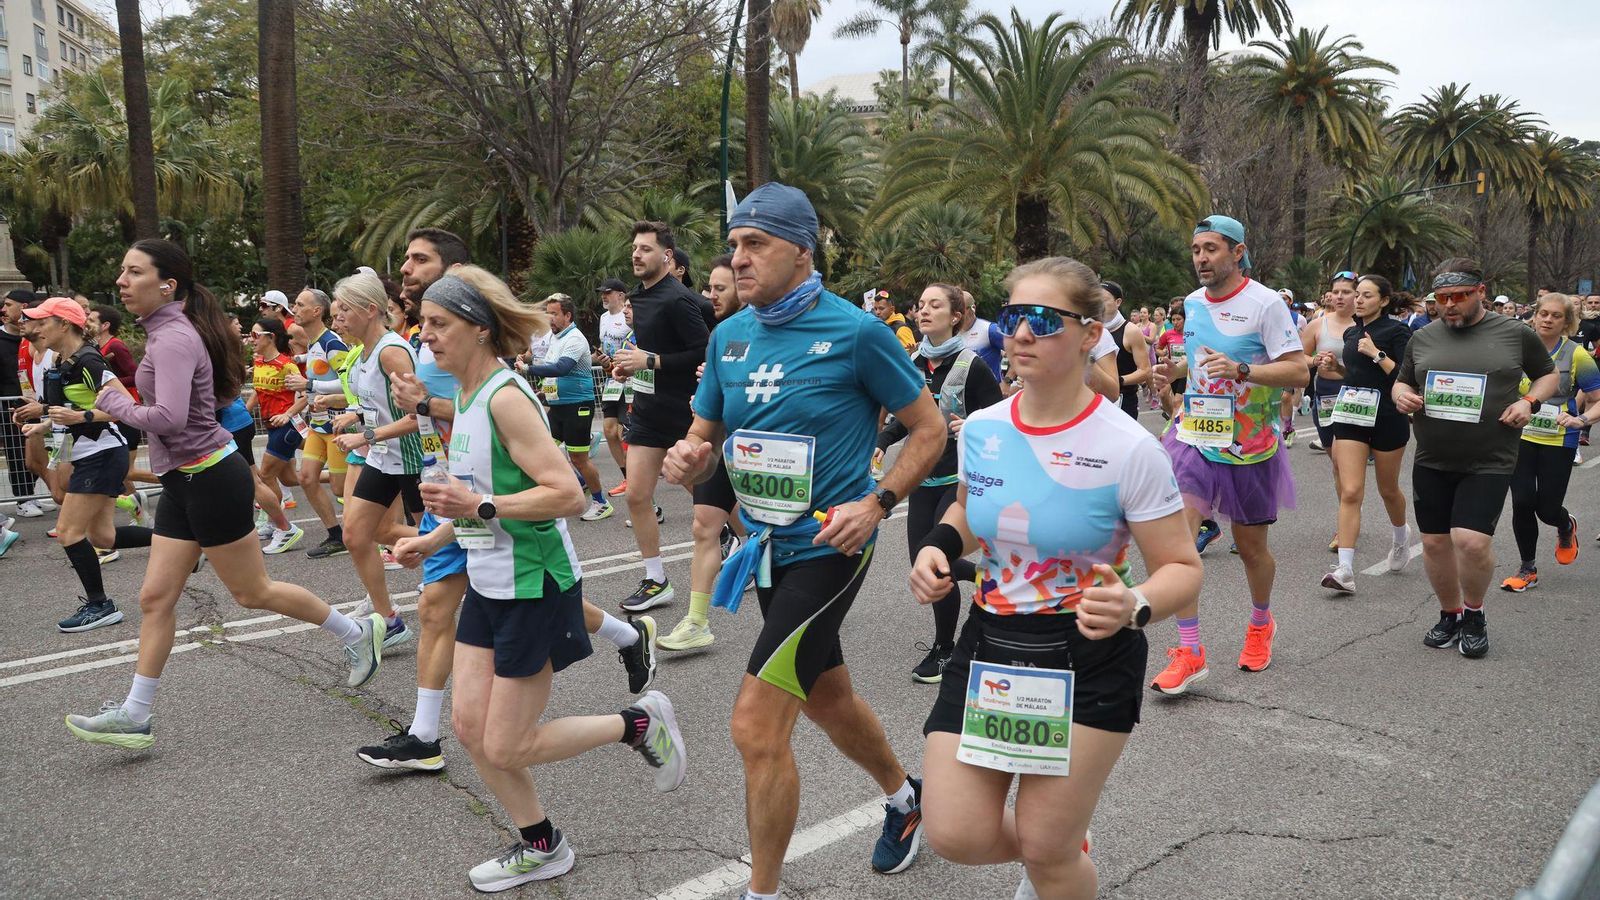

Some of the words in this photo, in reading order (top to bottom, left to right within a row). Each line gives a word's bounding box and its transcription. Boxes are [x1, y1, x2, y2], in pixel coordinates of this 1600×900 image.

[1436, 393, 1473, 407] 4435
[1342, 403, 1369, 415] 5501
[1193, 419, 1224, 433] 1485
[1530, 416, 1552, 428] 419
[741, 472, 794, 499] 4300
[985, 715, 1050, 746] 6080
